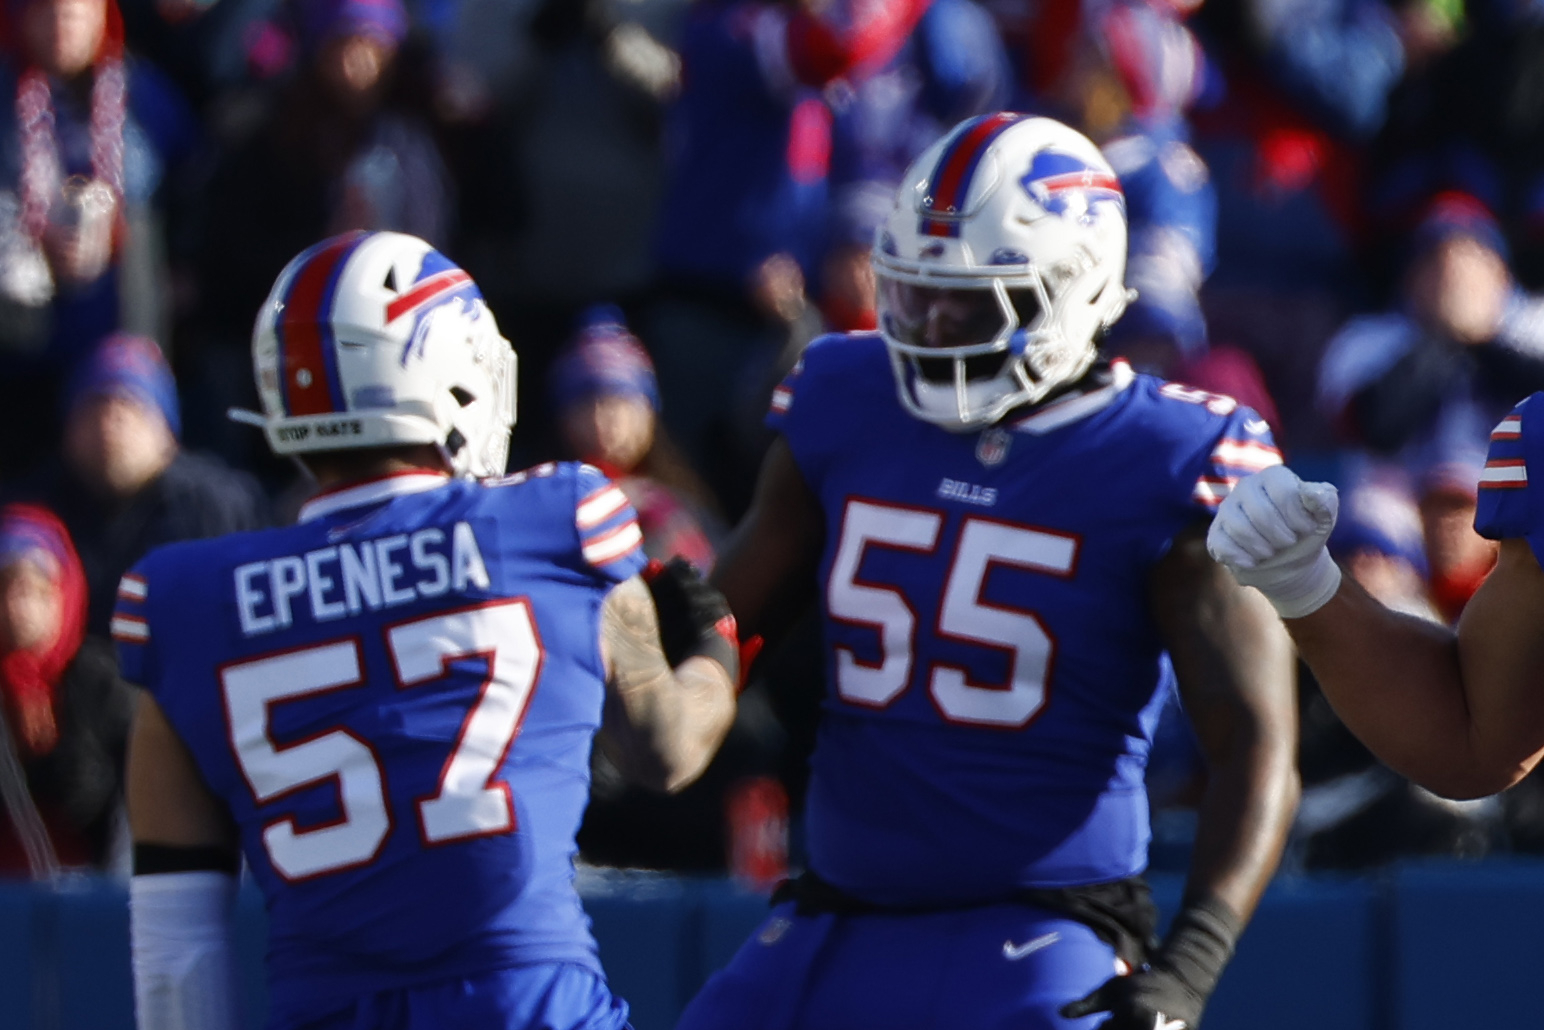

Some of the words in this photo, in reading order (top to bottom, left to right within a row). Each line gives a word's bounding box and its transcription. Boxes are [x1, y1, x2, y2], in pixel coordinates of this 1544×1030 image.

[233, 520, 491, 637] EPENESA
[936, 477, 998, 507] BILLS
[827, 495, 1082, 731] 55
[216, 595, 546, 883] 57
